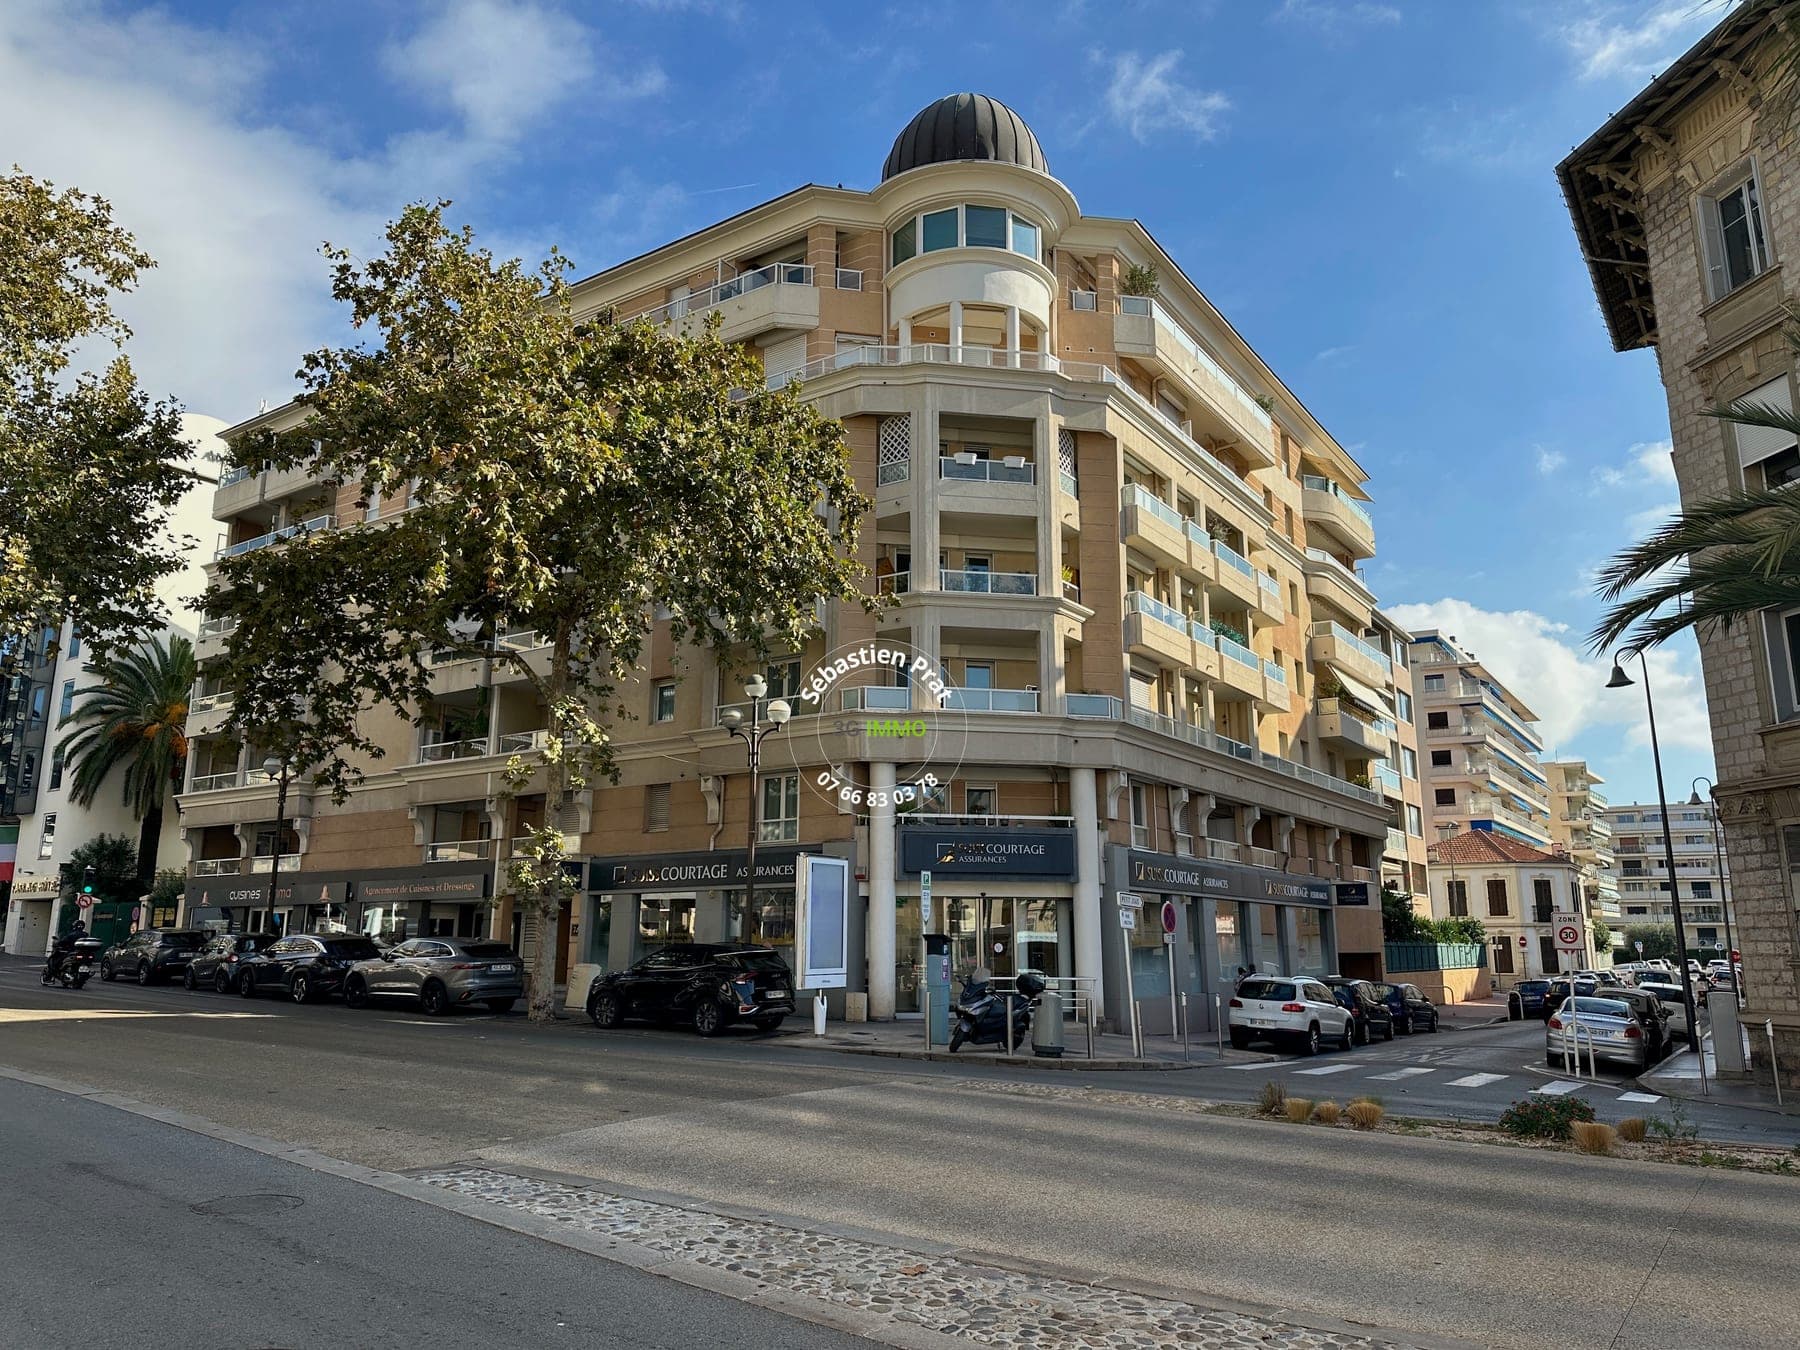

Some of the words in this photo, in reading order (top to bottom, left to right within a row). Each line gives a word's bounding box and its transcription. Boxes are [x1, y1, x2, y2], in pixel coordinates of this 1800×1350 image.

[958, 855, 1007, 864] ASSURANCES
[735, 864, 795, 877] ASURANCES
[399, 884, 408, 894] de
[408, 883, 435, 894] Cuisines
[435, 883, 442, 892] et
[443, 880, 475, 892] Dressings
[229, 889, 261, 901] cuisines
[1562, 931, 1575, 940] 30
